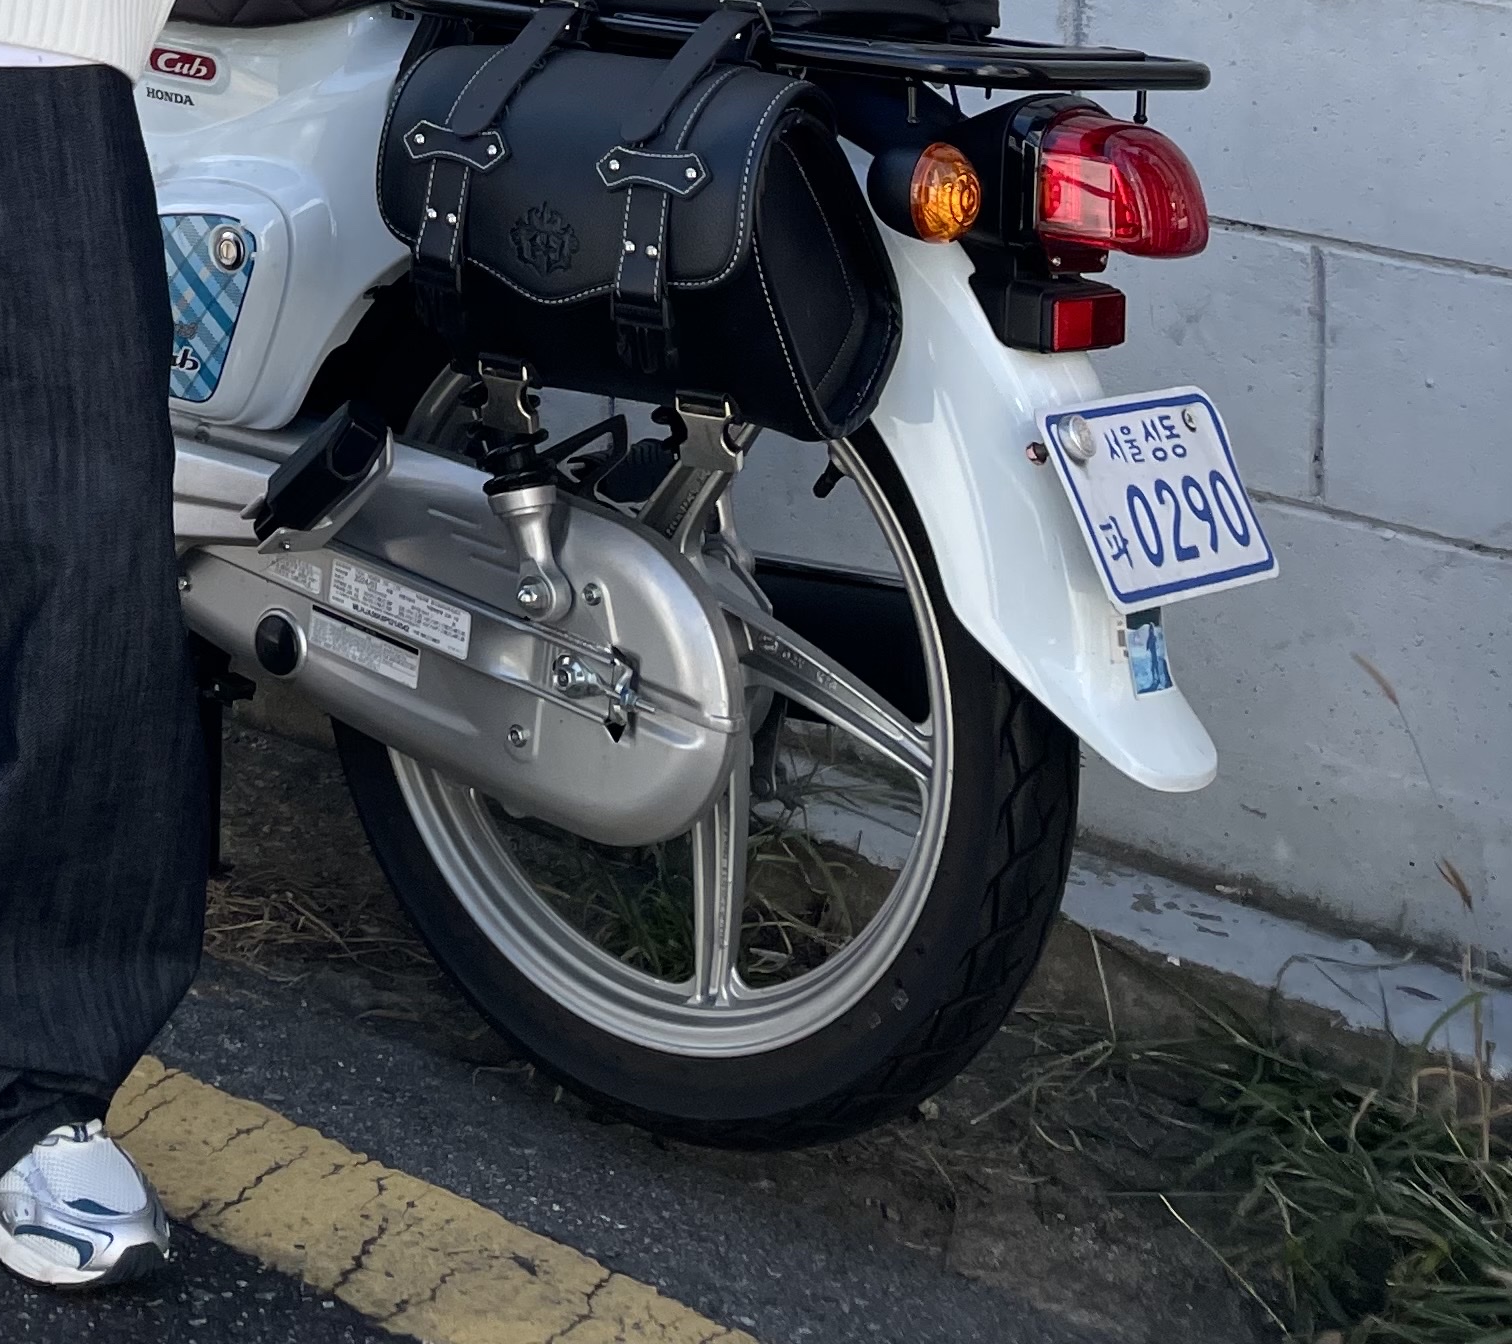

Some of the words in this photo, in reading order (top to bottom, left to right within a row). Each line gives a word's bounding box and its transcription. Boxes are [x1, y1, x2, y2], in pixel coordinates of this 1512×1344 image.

[156, 52, 208, 77] Cub
[146, 87, 195, 106] HONDA
[1126, 469, 1251, 568] 0290
